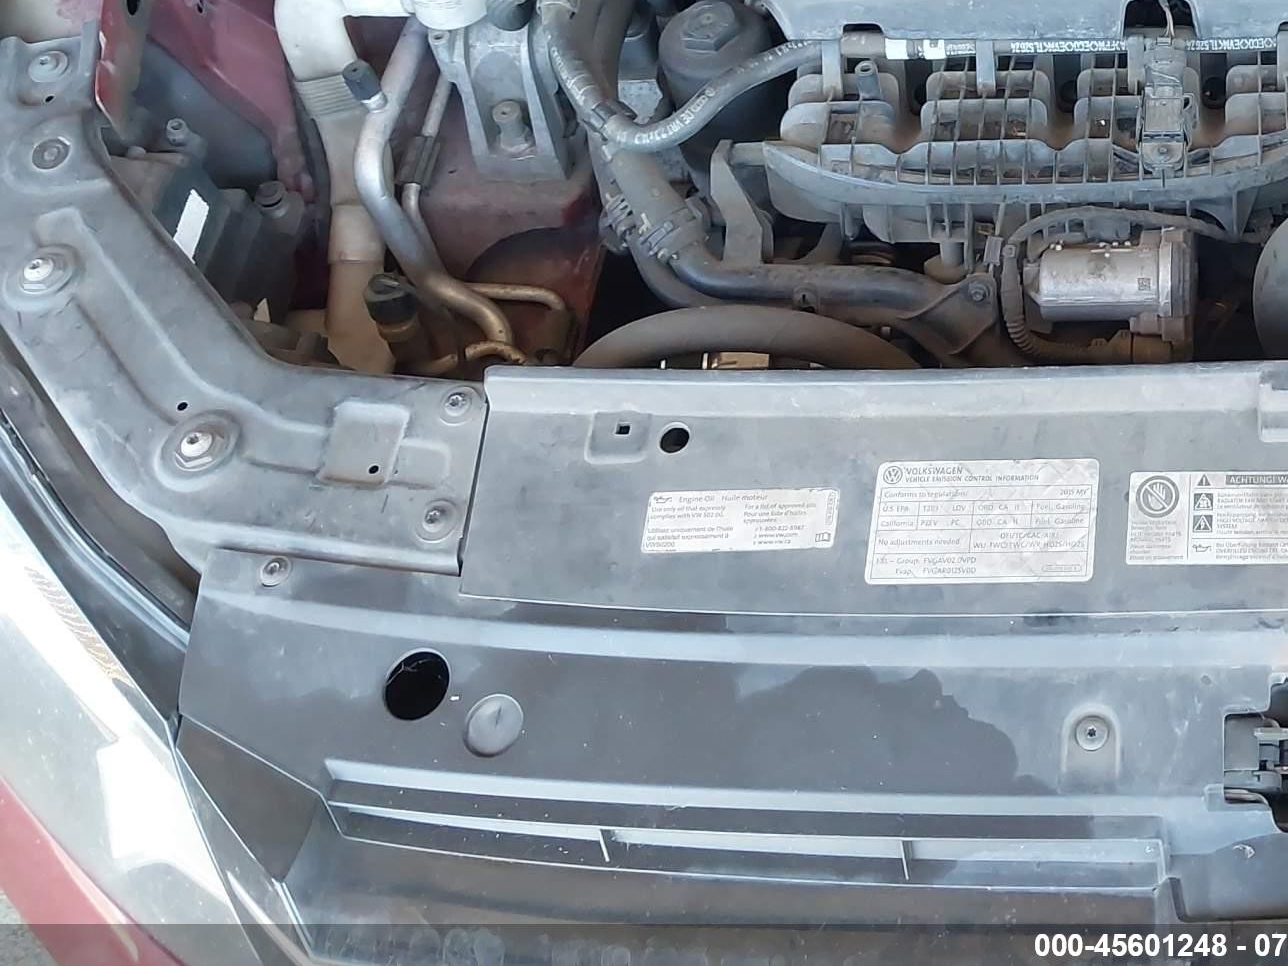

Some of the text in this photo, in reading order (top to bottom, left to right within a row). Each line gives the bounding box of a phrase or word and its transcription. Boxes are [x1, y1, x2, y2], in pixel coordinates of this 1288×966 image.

[906, 466, 963, 474] VOLKSWAGEN
[964, 474, 992, 482] CONTROL
[1230, 476, 1276, 484] ACHTUNG!
[884, 490, 917, 498] Conforms
[679, 496, 703, 504] Engine
[741, 494, 768, 502] moteur
[1056, 502, 1085, 510] Gasoline
[878, 537, 960, 546] No adjustments needed
